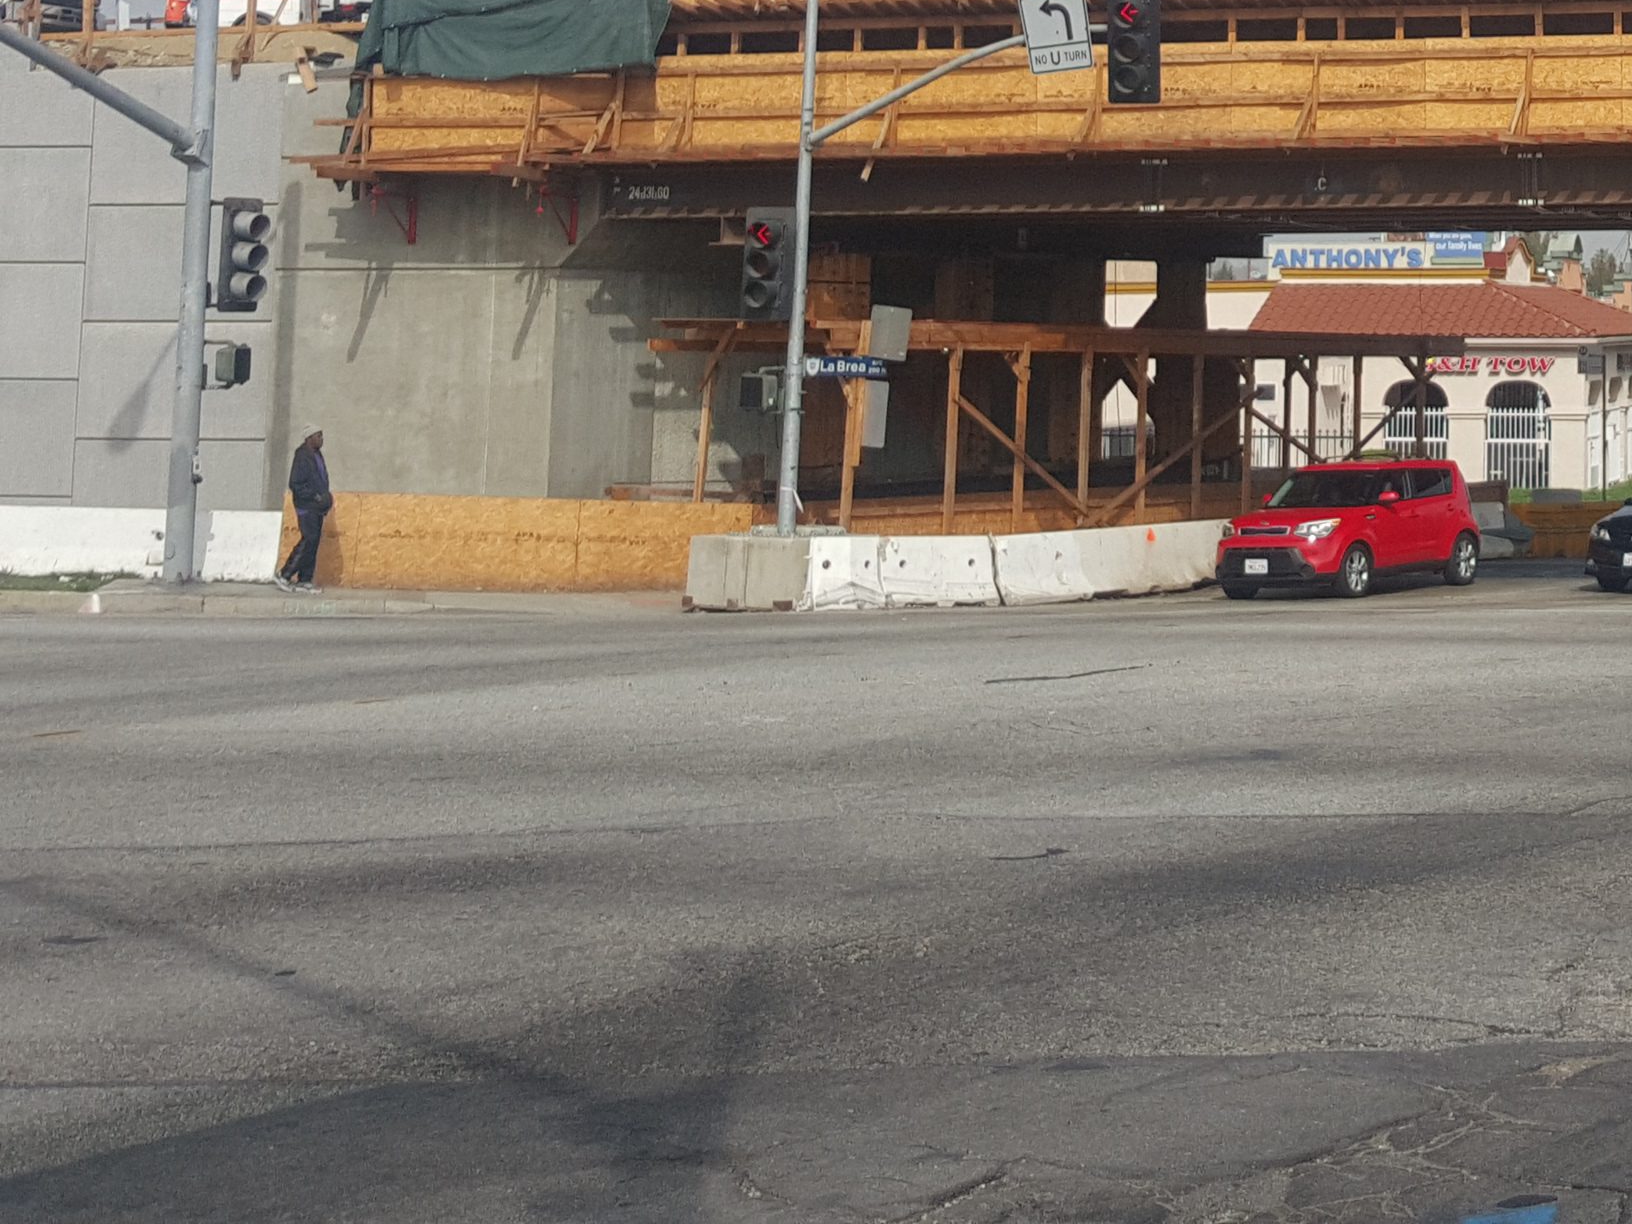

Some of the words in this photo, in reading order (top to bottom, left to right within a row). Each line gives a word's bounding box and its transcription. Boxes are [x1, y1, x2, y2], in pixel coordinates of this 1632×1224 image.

[1035, 54, 1047, 65] NO
[1050, 50, 1061, 65] U
[1064, 50, 1088, 62] TURN
[1448, 240, 1467, 251] family
[1272, 246, 1424, 269] ANTHONY'S
[820, 359, 835, 372] La
[836, 360, 866, 373] Brea
[1487, 356, 1556, 375] TOW
